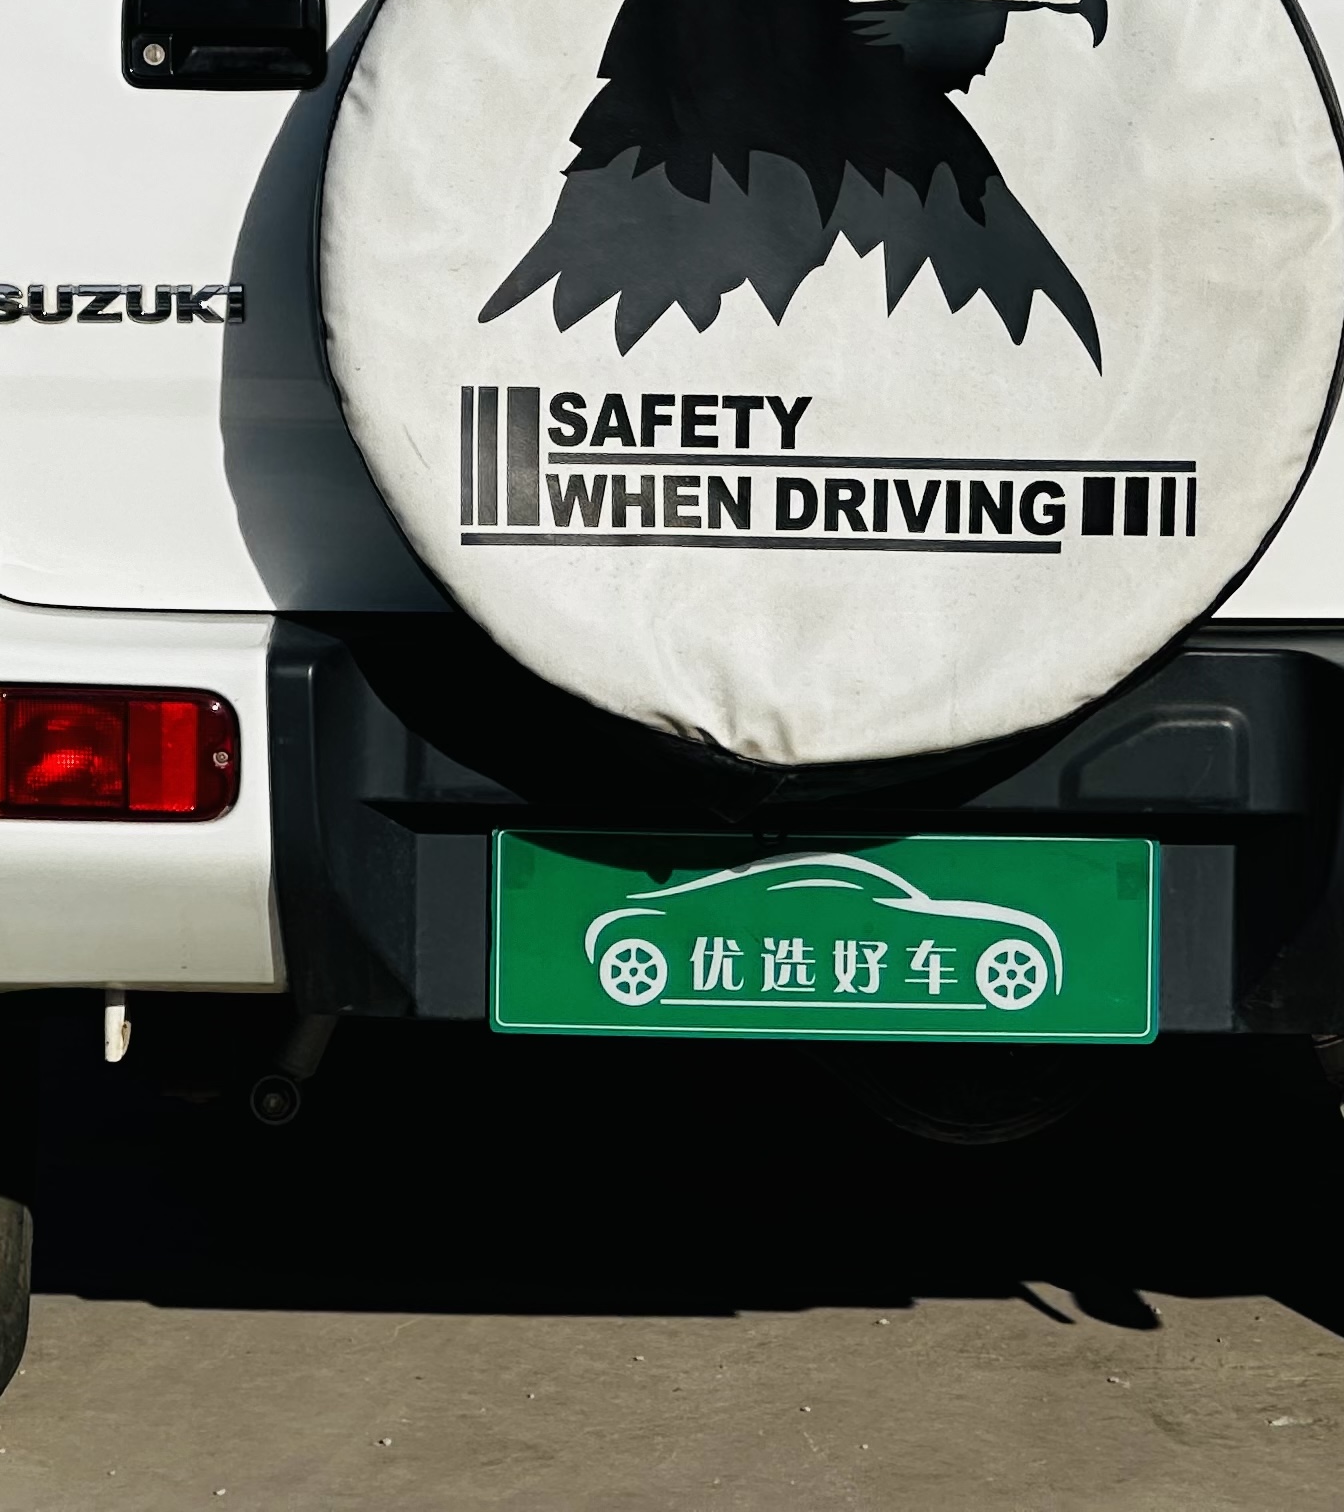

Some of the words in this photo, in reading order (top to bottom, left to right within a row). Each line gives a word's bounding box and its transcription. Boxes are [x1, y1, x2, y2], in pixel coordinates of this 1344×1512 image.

[547, 392, 813, 450] SAFETY
[546, 474, 751, 530] WHEN
[775, 477, 1066, 536] DRIVING
[689, 936, 958, 996] 优选好车
